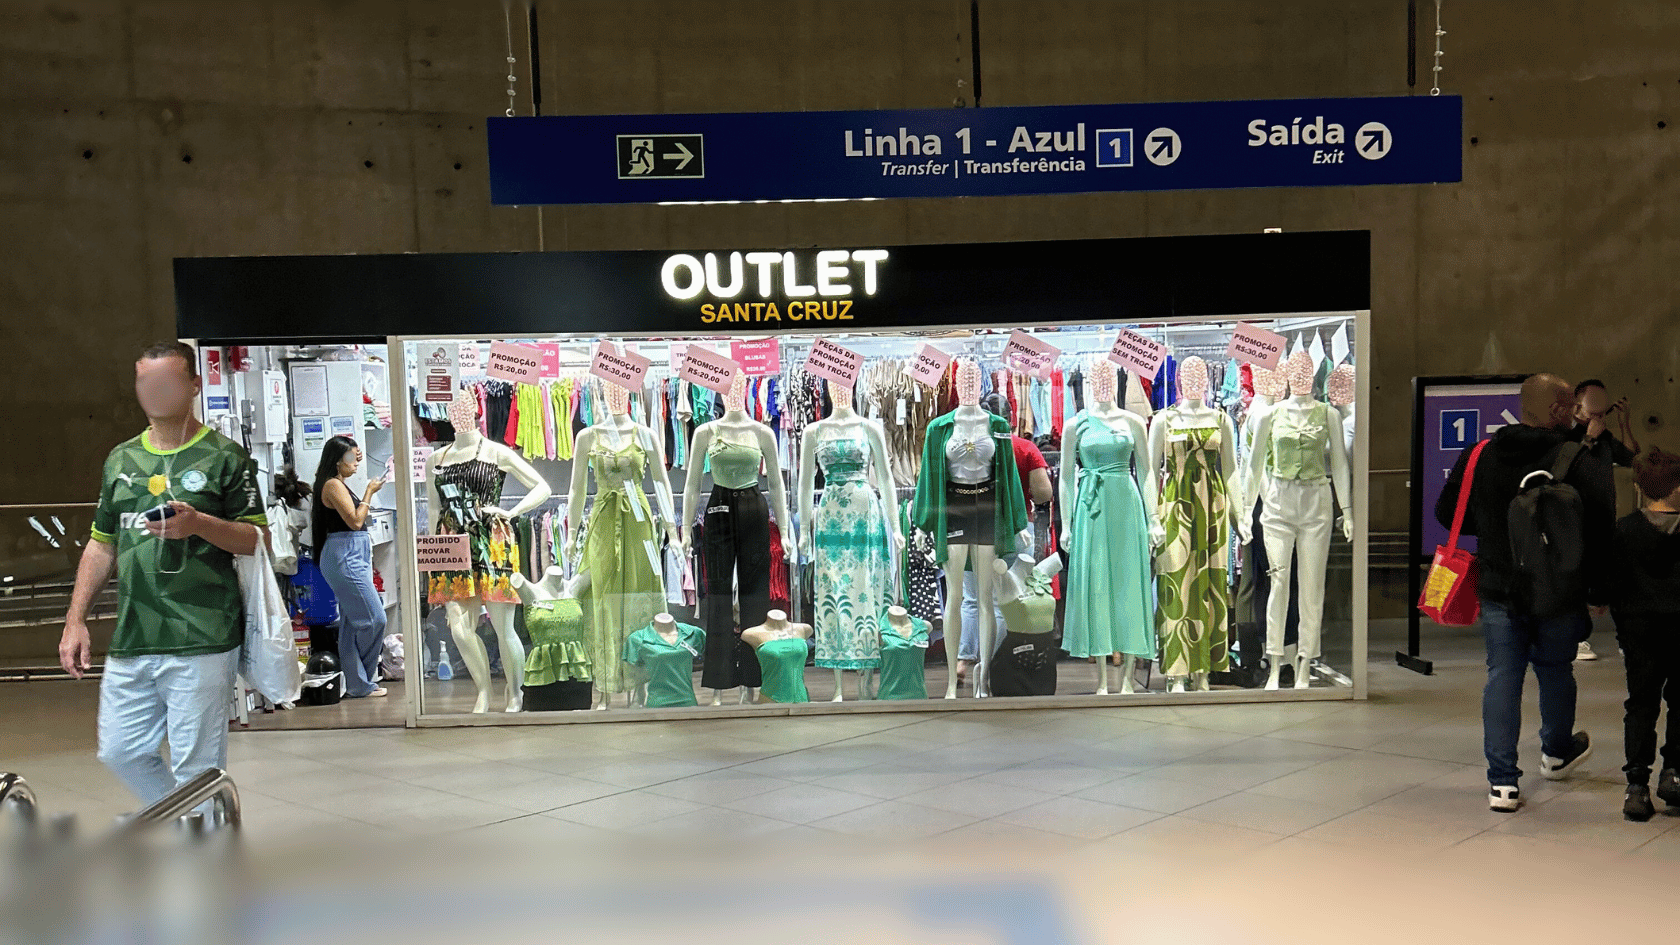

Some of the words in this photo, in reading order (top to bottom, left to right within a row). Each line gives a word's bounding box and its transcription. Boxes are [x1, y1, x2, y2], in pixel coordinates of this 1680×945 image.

[844, 127, 942, 157] Linha
[955, 128, 971, 154] 1
[1008, 123, 1086, 153] Azul
[1247, 116, 1345, 147] Saída
[1108, 138, 1121, 158] 1
[1312, 149, 1345, 164] Exit
[881, 160, 949, 176] Transfer
[963, 157, 1086, 174] Transferência
[660, 249, 890, 300] OUTLET
[700, 302, 782, 323] SANTA
[787, 300, 854, 320] CRUZ
[818, 340, 844, 356] PEÇAS
[844, 351, 856, 361] DA
[1116, 338, 1159, 362] PROMOÇÃO
[1122, 330, 1148, 347] PEÇAS
[1148, 342, 1159, 352] DA
[1234, 333, 1278, 353] PROMOÇÃO
[491, 352, 537, 368] PROMOÇÃO
[598, 351, 642, 374] PROMOÇÃO
[686, 356, 730, 377] PROMOÇÃO
[808, 357, 826, 369] SEM
[827, 364, 852, 380] TROCA
[812, 348, 856, 371] PROMOÇÃO
[1111, 347, 1129, 359] SEM
[1130, 355, 1155, 372] TROCA
[1452, 417, 1465, 442] 1
[417, 536, 460, 545] PROIBIDO
[417, 547, 451, 555] PROVAR
